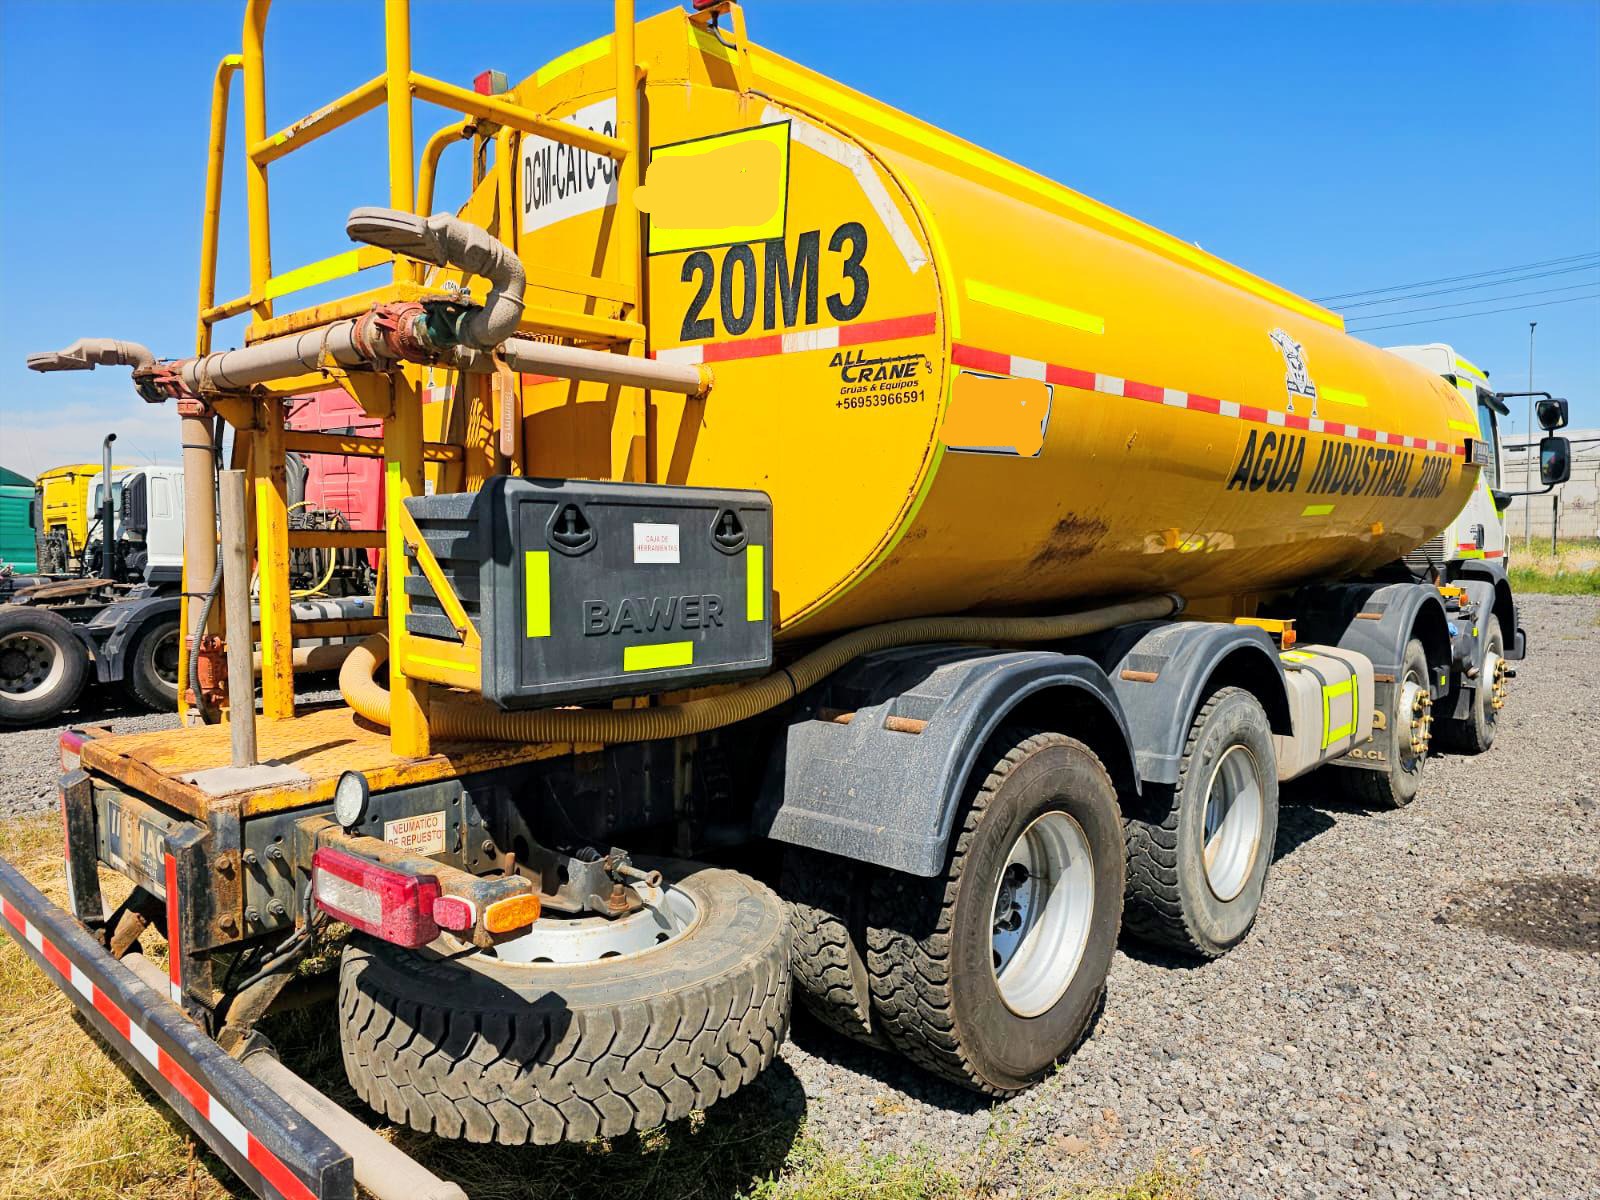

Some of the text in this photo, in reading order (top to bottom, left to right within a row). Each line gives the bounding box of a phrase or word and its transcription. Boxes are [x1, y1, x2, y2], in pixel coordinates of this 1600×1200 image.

[680, 221, 870, 342] 20M3
[829, 349, 868, 367] ALL
[841, 362, 919, 383] CRANE
[869, 383, 877, 392] &
[879, 380, 919, 391] Equipos
[836, 389, 925, 410] +56953966591
[1226, 429, 1452, 499] AGUA INDUSTRIAL 20M3
[583, 594, 724, 637] BAWER
[392, 816, 439, 835] NEUMATICO
[400, 829, 443, 847] REPUESTO
